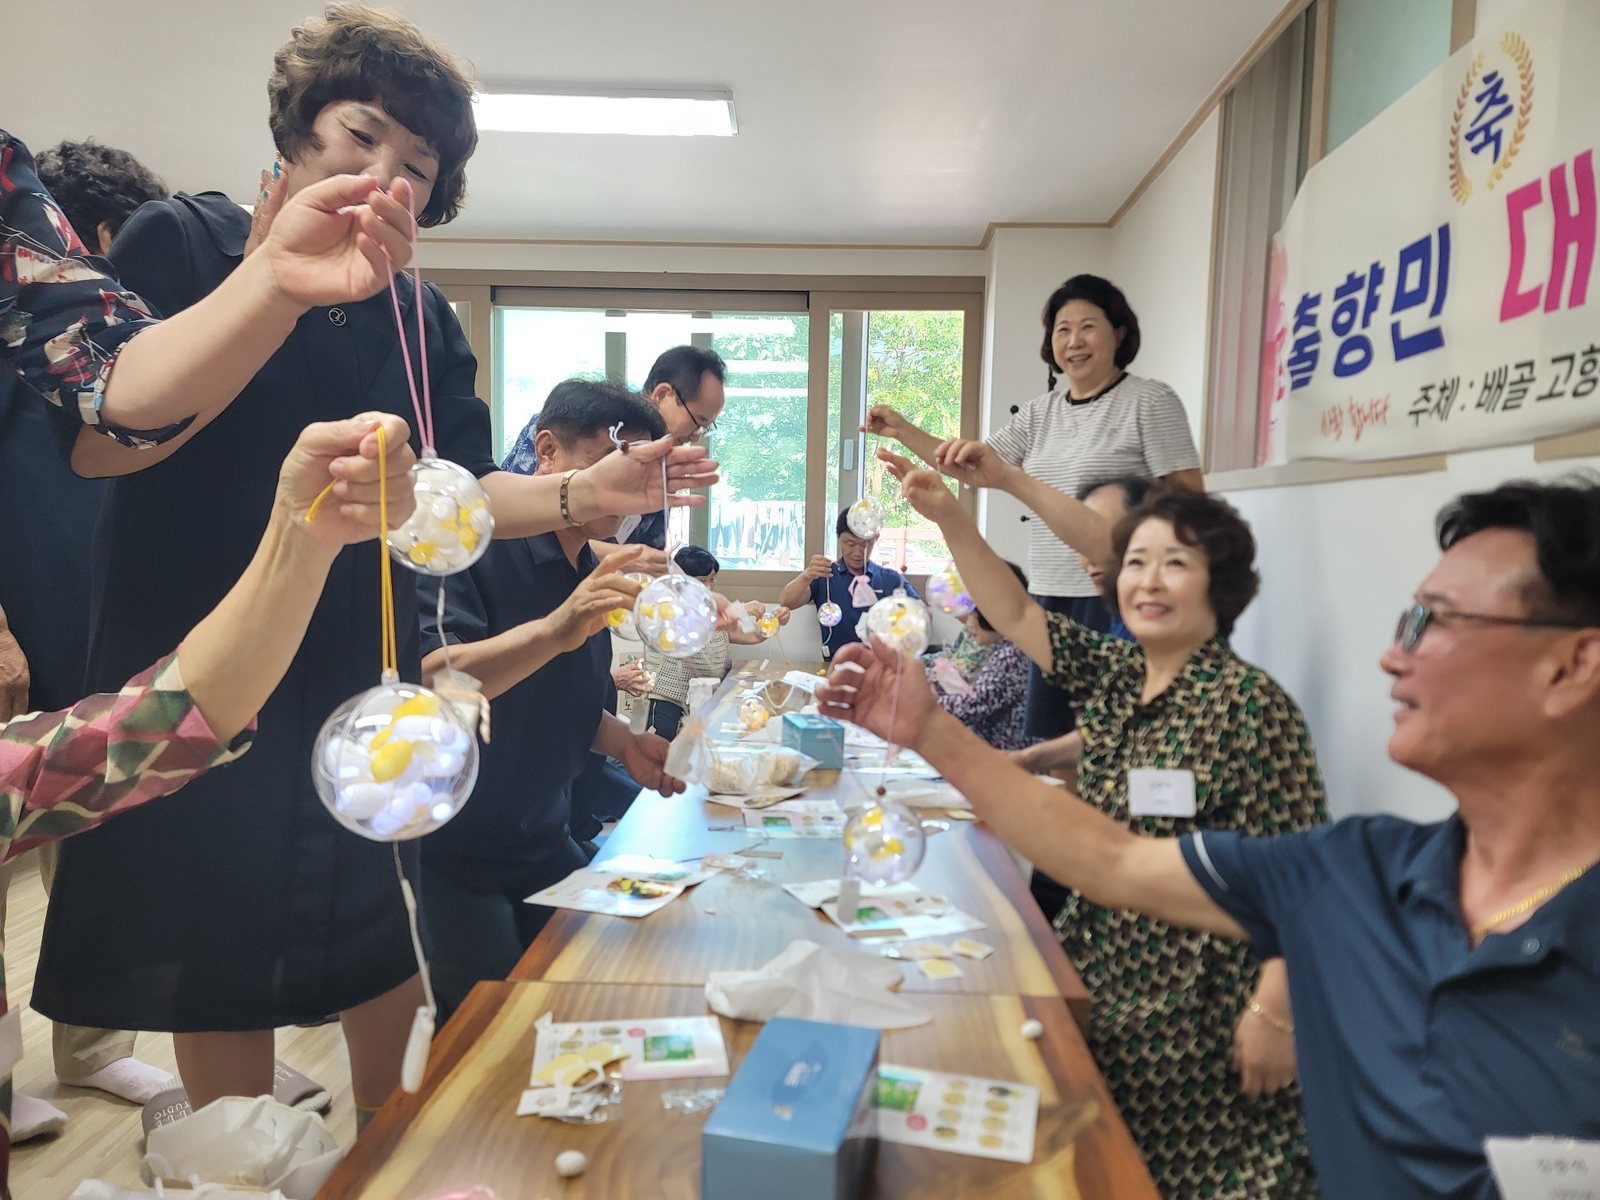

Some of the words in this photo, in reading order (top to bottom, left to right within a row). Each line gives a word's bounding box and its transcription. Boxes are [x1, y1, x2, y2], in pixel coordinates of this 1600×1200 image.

[1464, 70, 1514, 165] 축
[1499, 148, 1598, 324] 대
[1475, 359, 1537, 413] 배골
[153, 1100, 191, 1121] TUDIO
